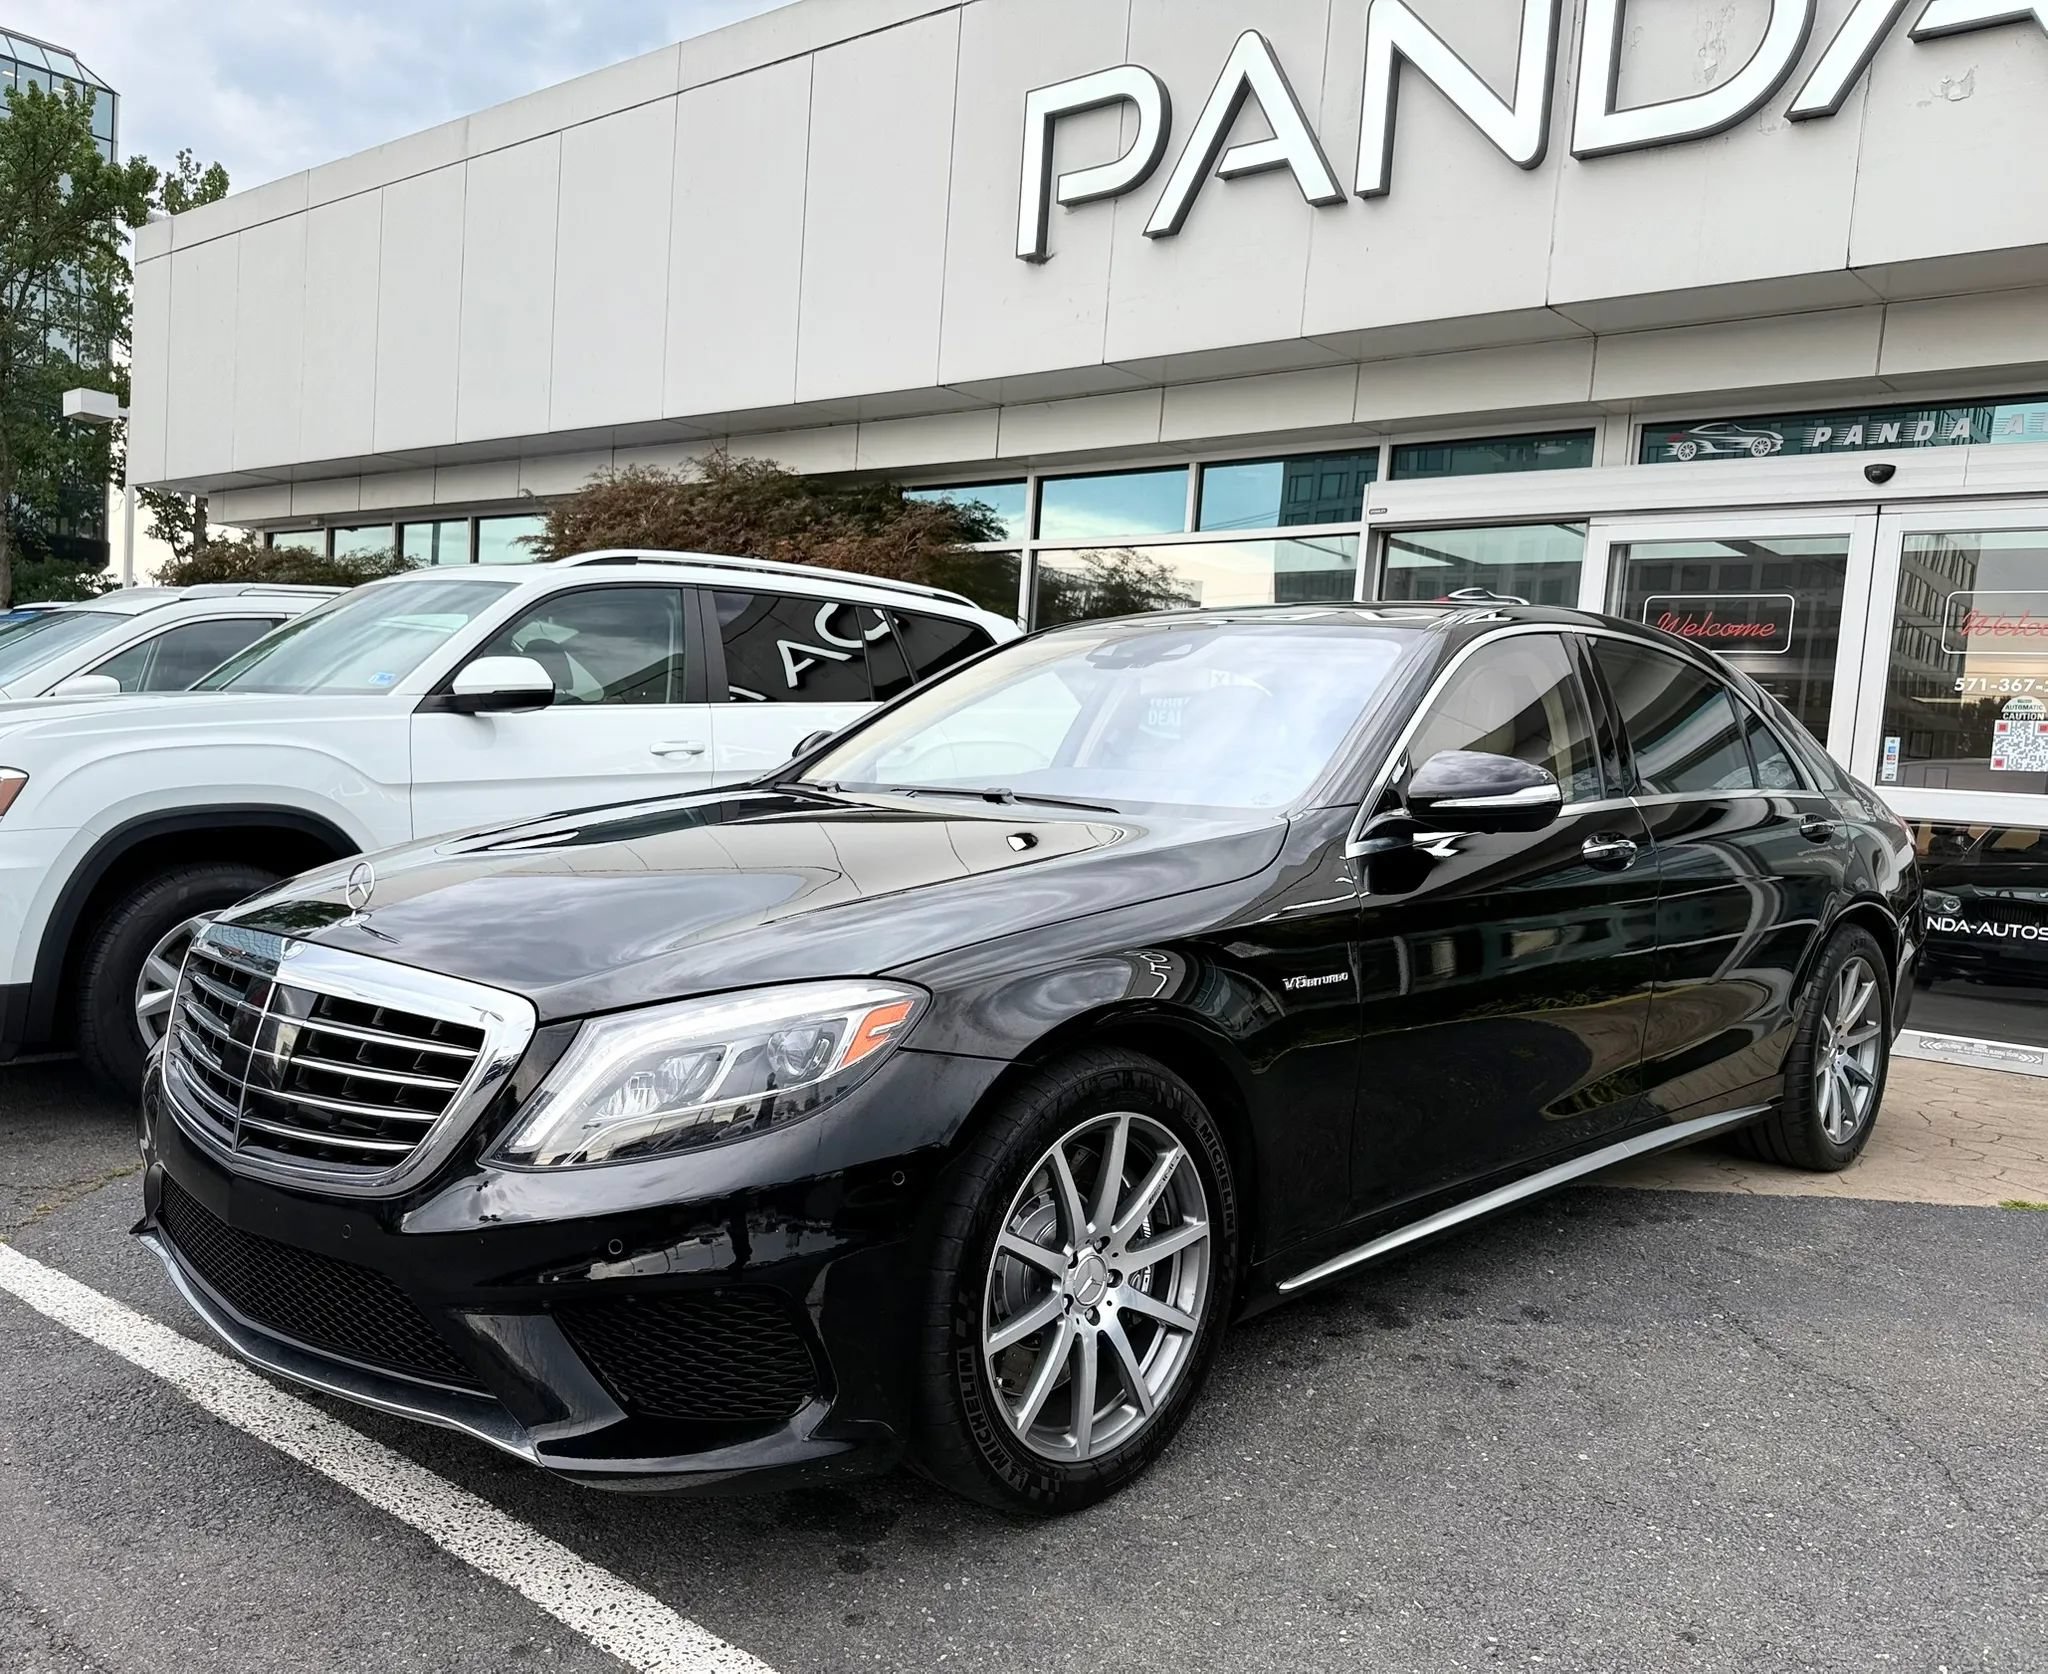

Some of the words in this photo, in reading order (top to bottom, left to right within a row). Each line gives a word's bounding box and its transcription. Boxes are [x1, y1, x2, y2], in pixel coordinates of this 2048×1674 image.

[1801, 417, 1970, 447] PANDA
[1657, 611, 1776, 637] Welcome
[2002, 712, 2045, 721] CAUTION
[2004, 703, 2044, 711] AUTOMATIC
[1199, 1121, 1237, 1232] MICHELIN
[957, 1349, 1012, 1471] MICHELIN
